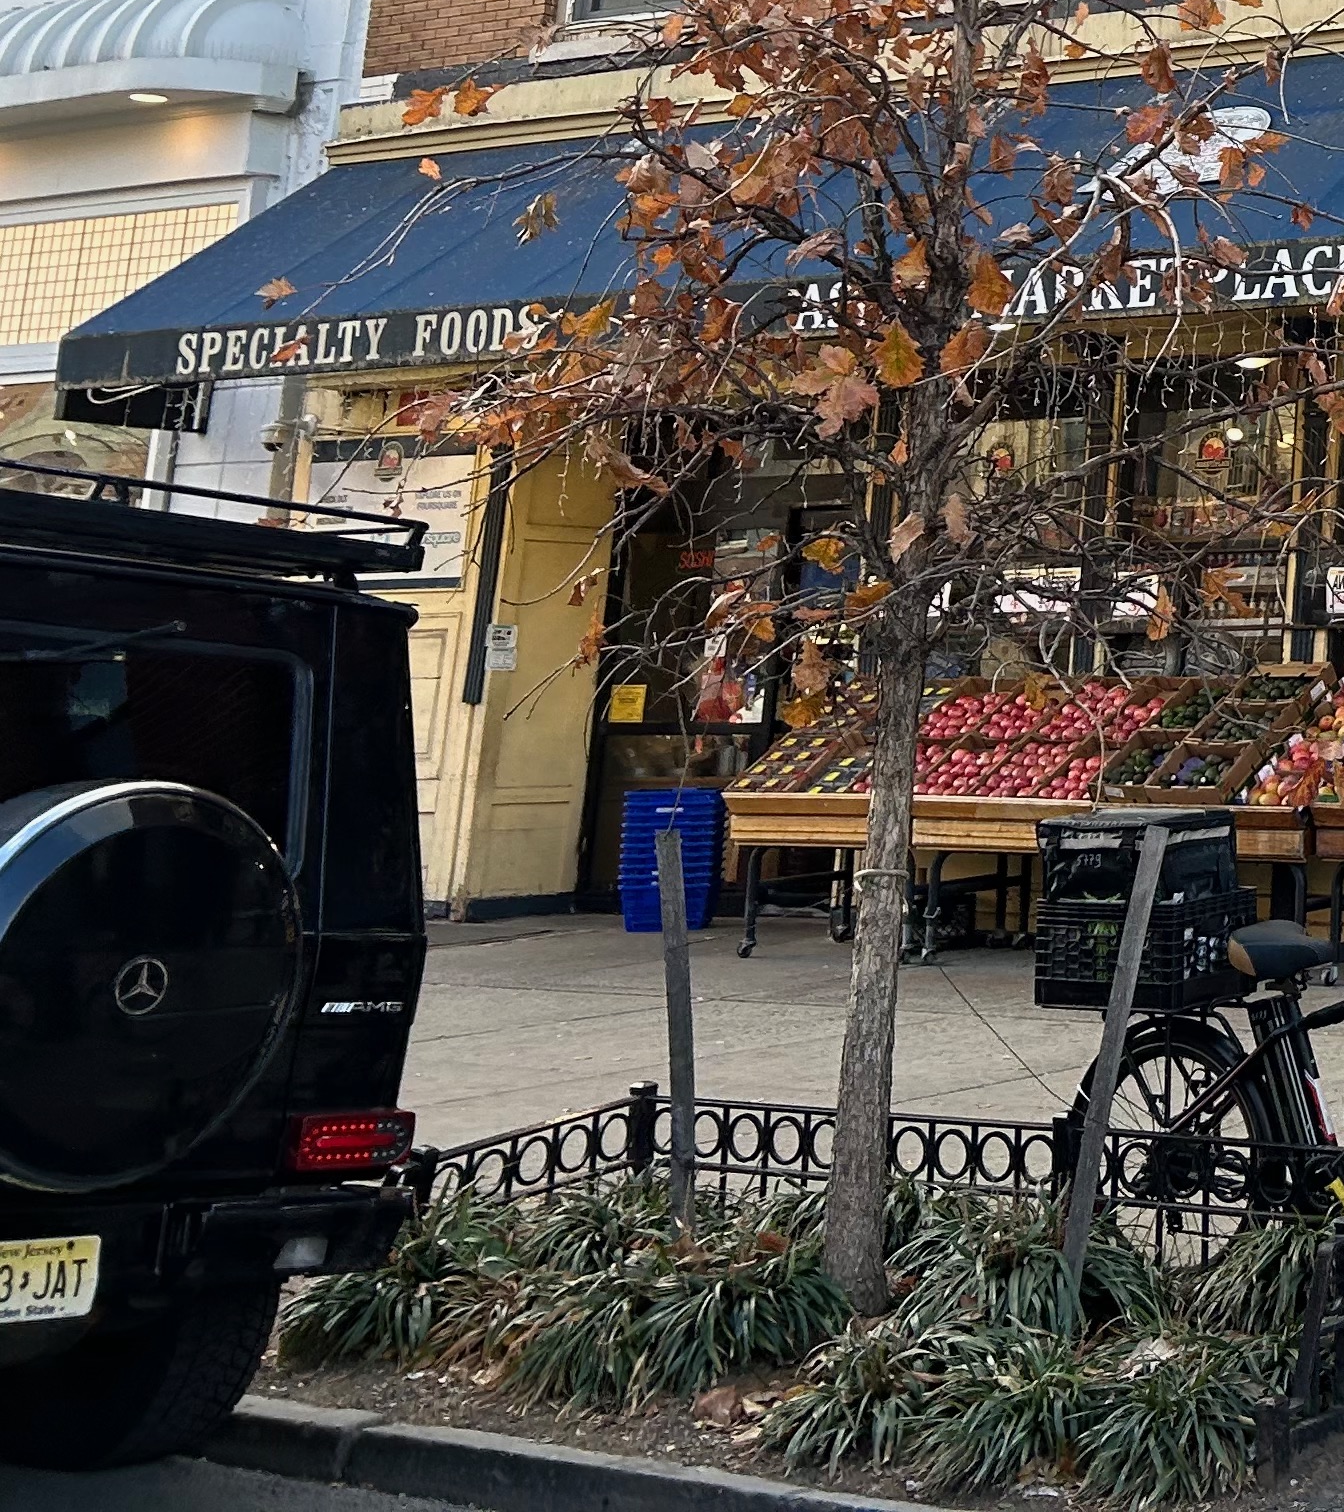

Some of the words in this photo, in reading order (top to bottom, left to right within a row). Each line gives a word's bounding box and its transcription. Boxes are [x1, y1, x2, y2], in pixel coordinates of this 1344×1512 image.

[176, 318, 388, 375] SPECIALTY
[412, 305, 541, 357] FOODS
[351, 1001, 405, 1013] AMG
[32, 1258, 88, 1300] JAT
